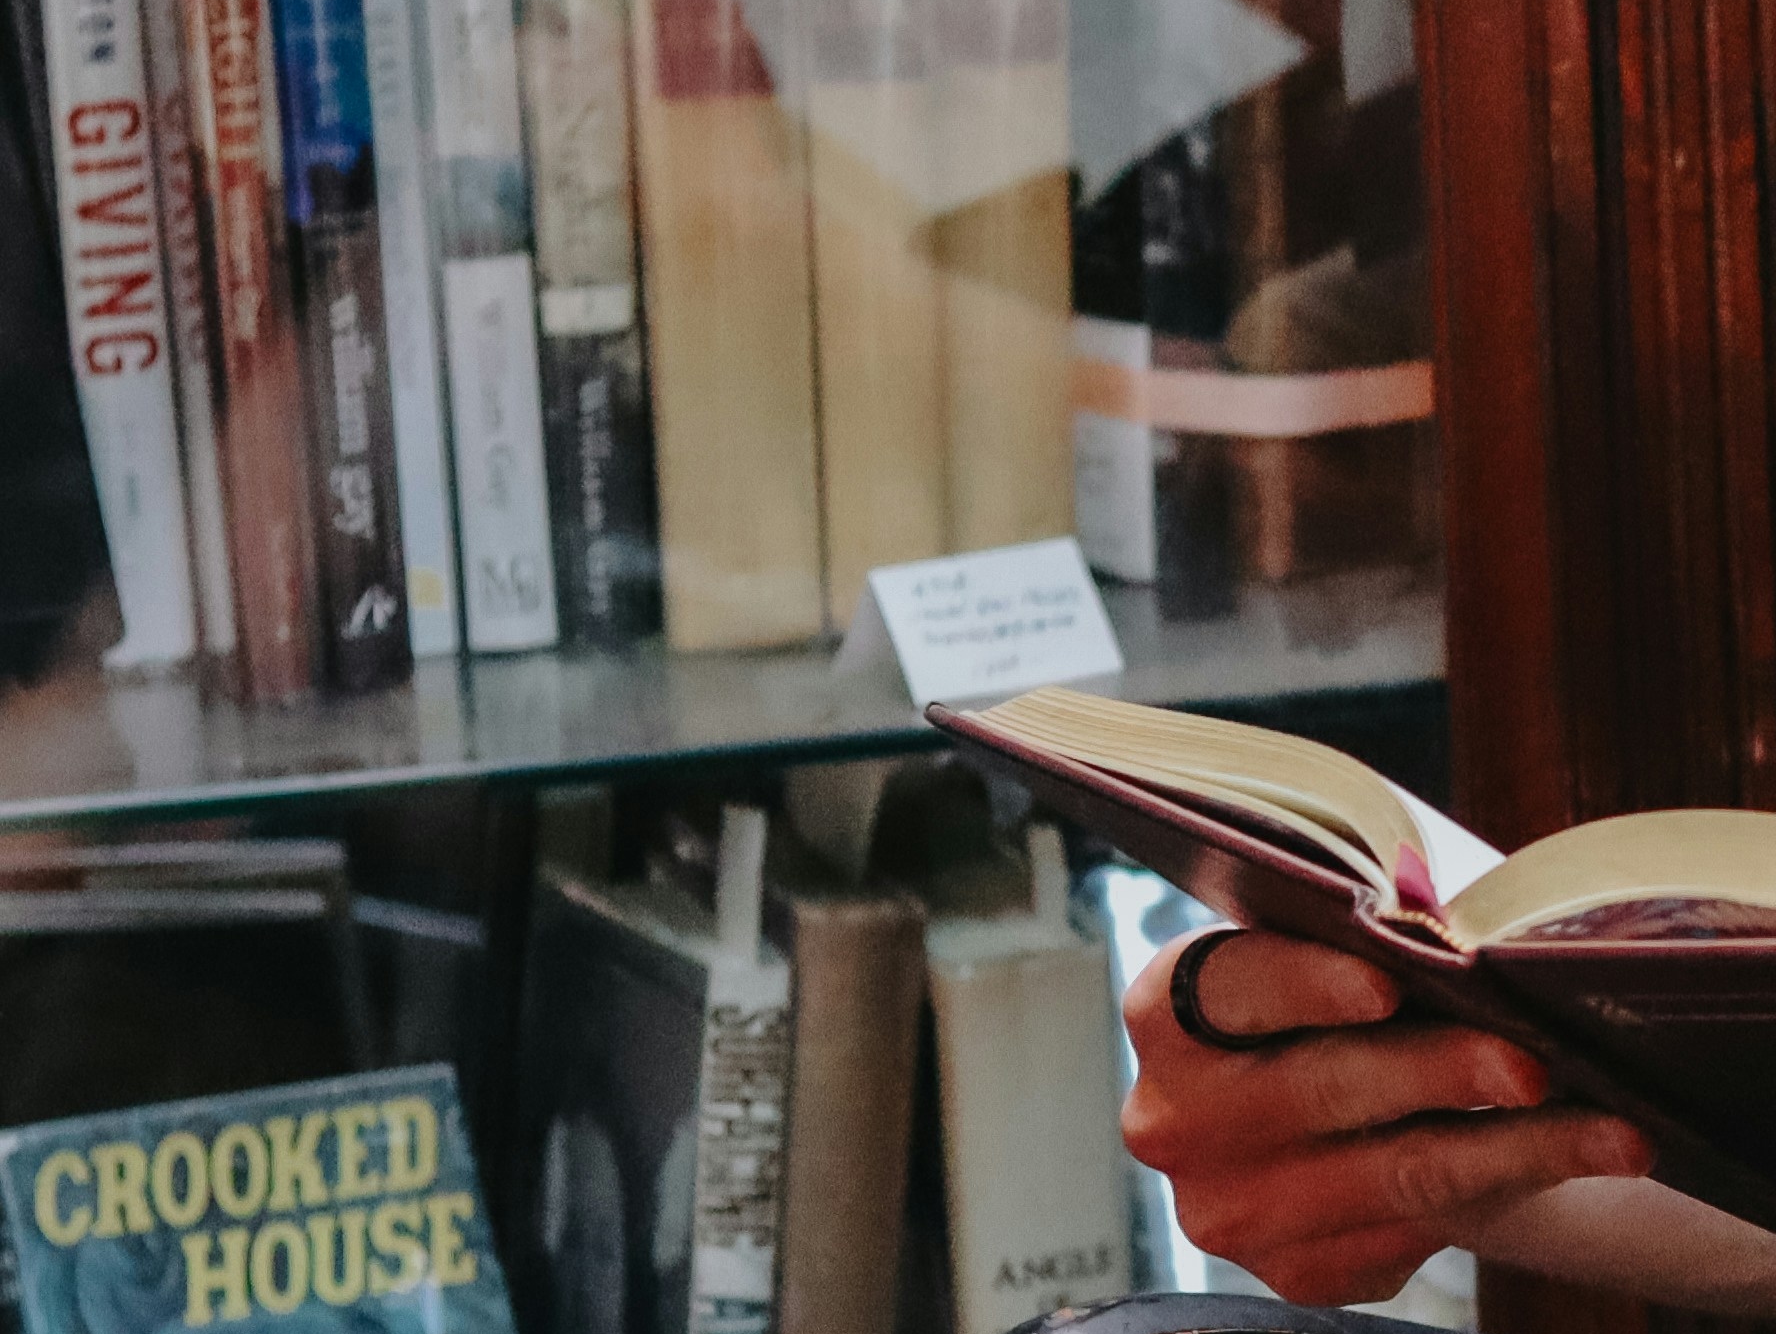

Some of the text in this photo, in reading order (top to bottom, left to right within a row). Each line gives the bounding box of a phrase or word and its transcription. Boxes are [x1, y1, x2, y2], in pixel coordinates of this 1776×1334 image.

[67, 98, 163, 380] GIVING
[35, 1095, 440, 1247] CROOKED
[181, 1192, 478, 1329] HOUSE
[992, 1244, 1113, 1293] ANGLE
